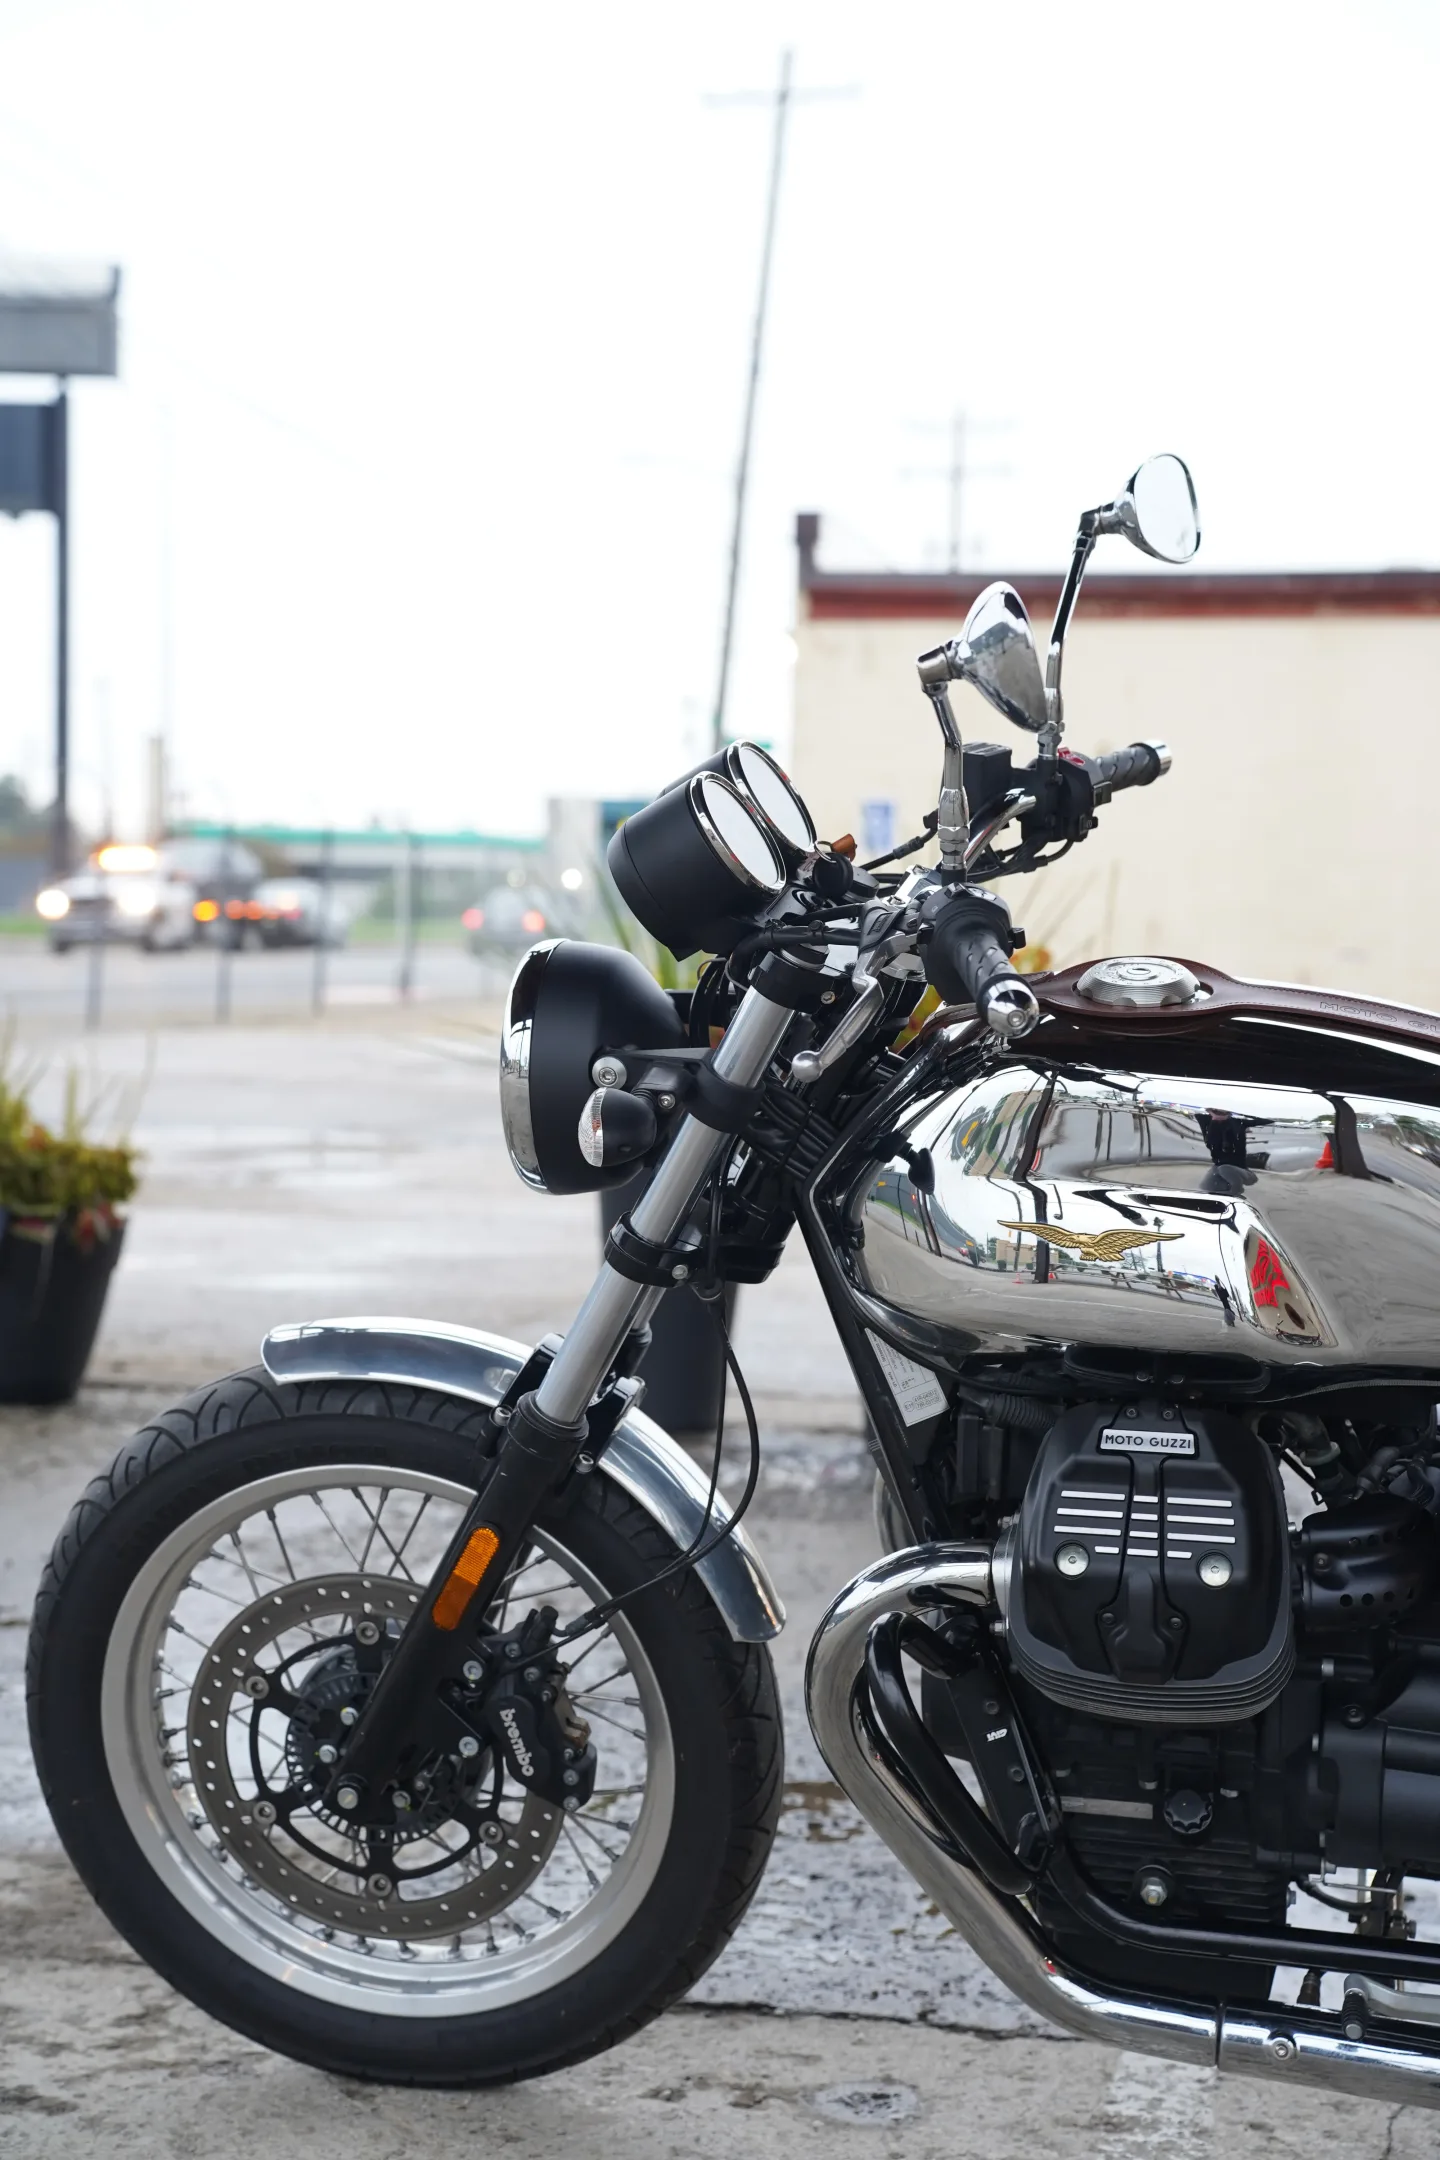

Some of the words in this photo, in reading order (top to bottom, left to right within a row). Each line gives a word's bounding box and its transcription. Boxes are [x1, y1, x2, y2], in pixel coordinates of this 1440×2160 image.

[1320, 1002, 1397, 1022] MOTO
[1105, 1434, 1144, 1446] MOTO
[1149, 1437, 1191, 1449] GUZZI
[499, 1708, 534, 1777] brembo
